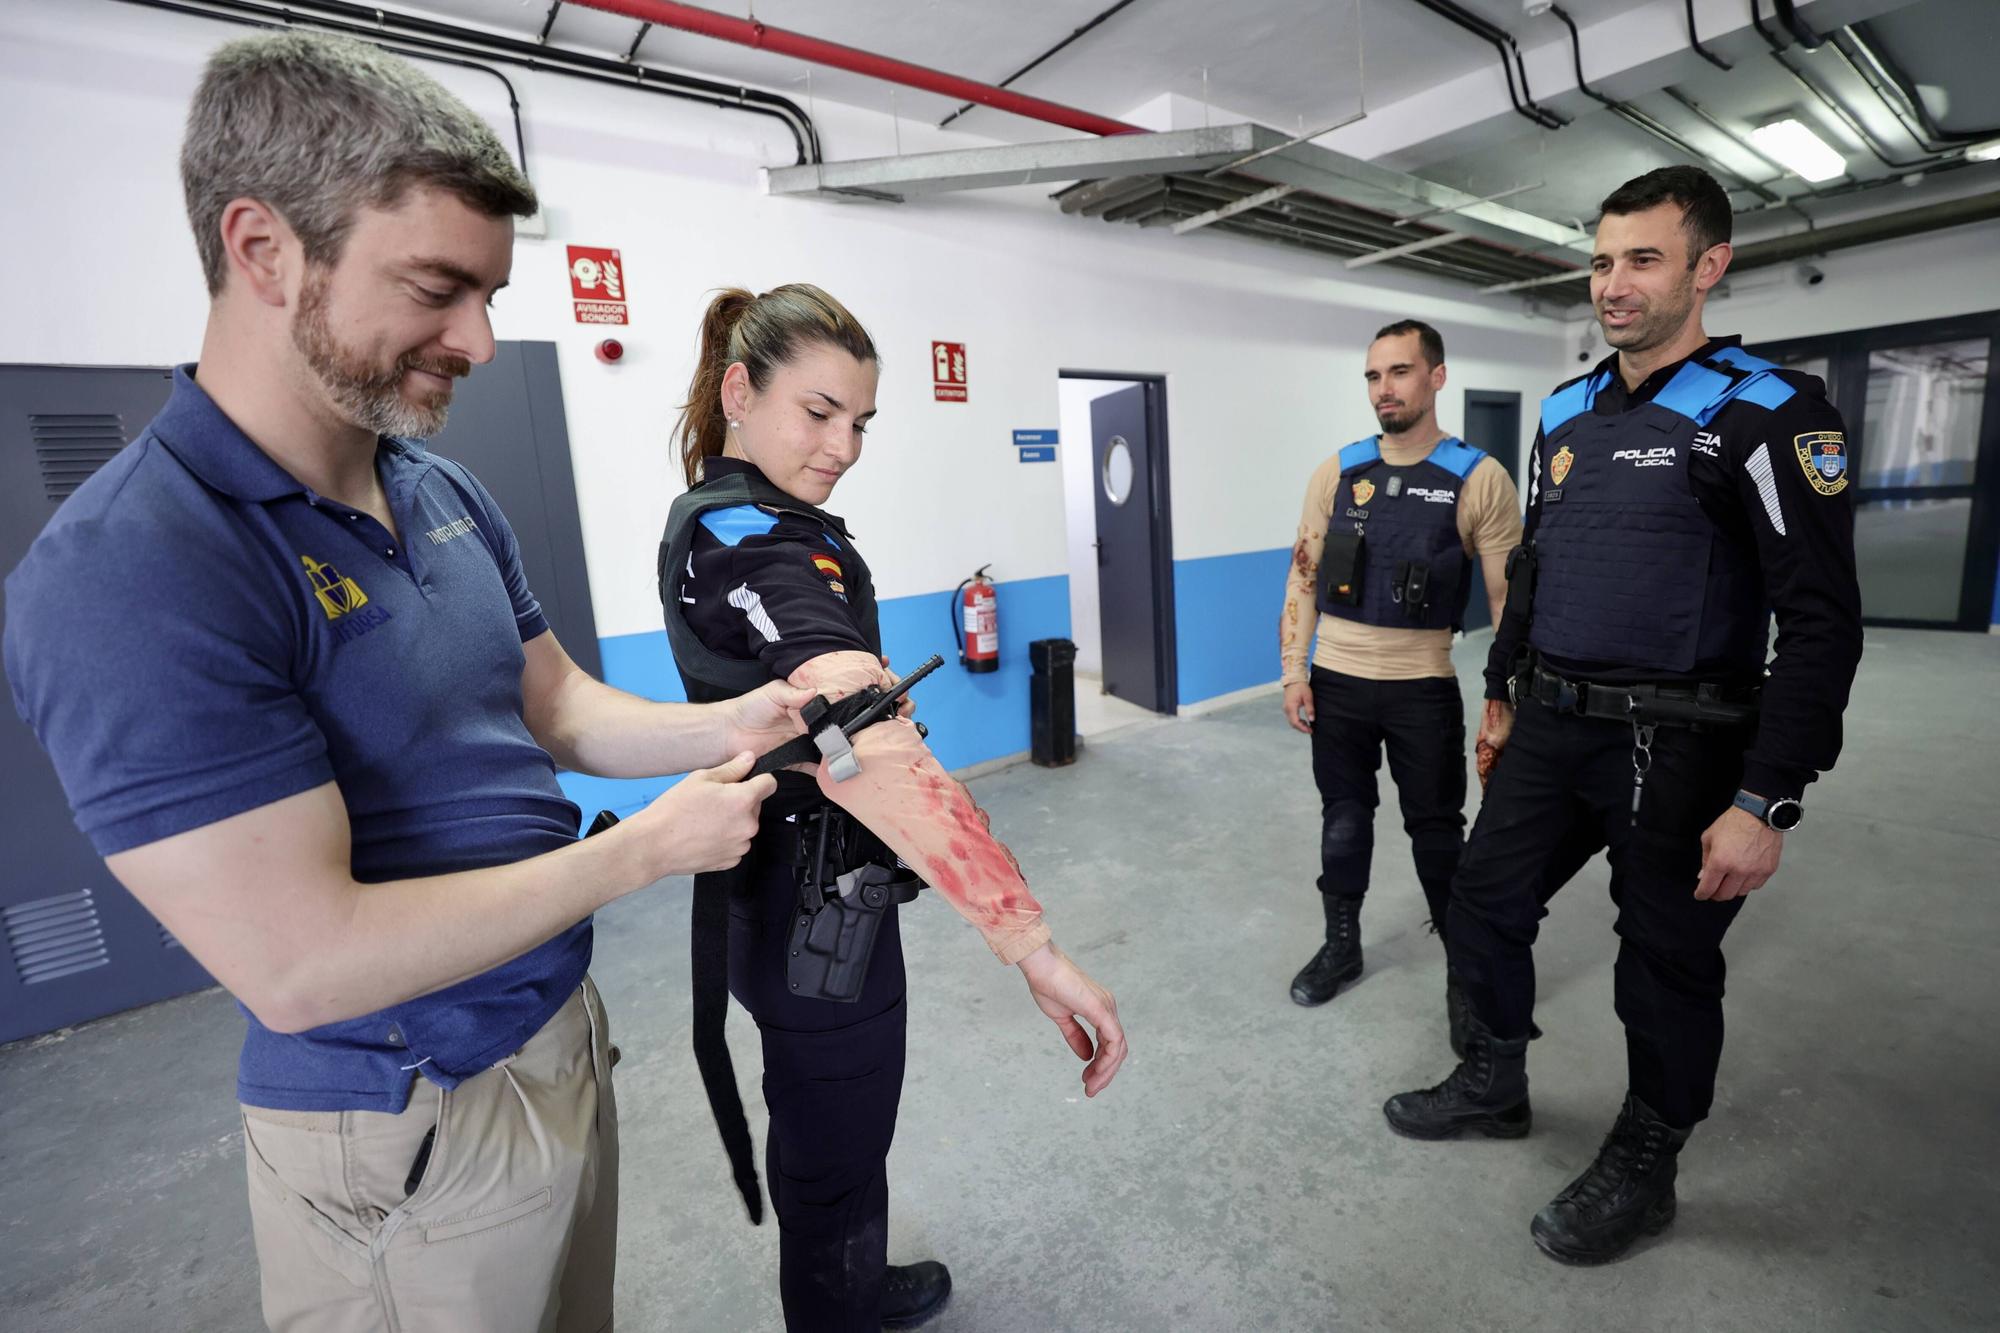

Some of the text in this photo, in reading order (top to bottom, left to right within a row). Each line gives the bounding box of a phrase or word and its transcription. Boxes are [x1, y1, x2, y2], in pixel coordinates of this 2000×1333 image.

[576, 303, 626, 315] AVISADOR
[581, 312, 624, 323] SONORO
[1612, 447, 1676, 461] POLICIA
[1634, 459, 1675, 468] LOCAL
[1799, 447, 1817, 478] POLICIA
[1406, 487, 1455, 499] POLICIA
[1423, 495, 1454, 504] LOCAL
